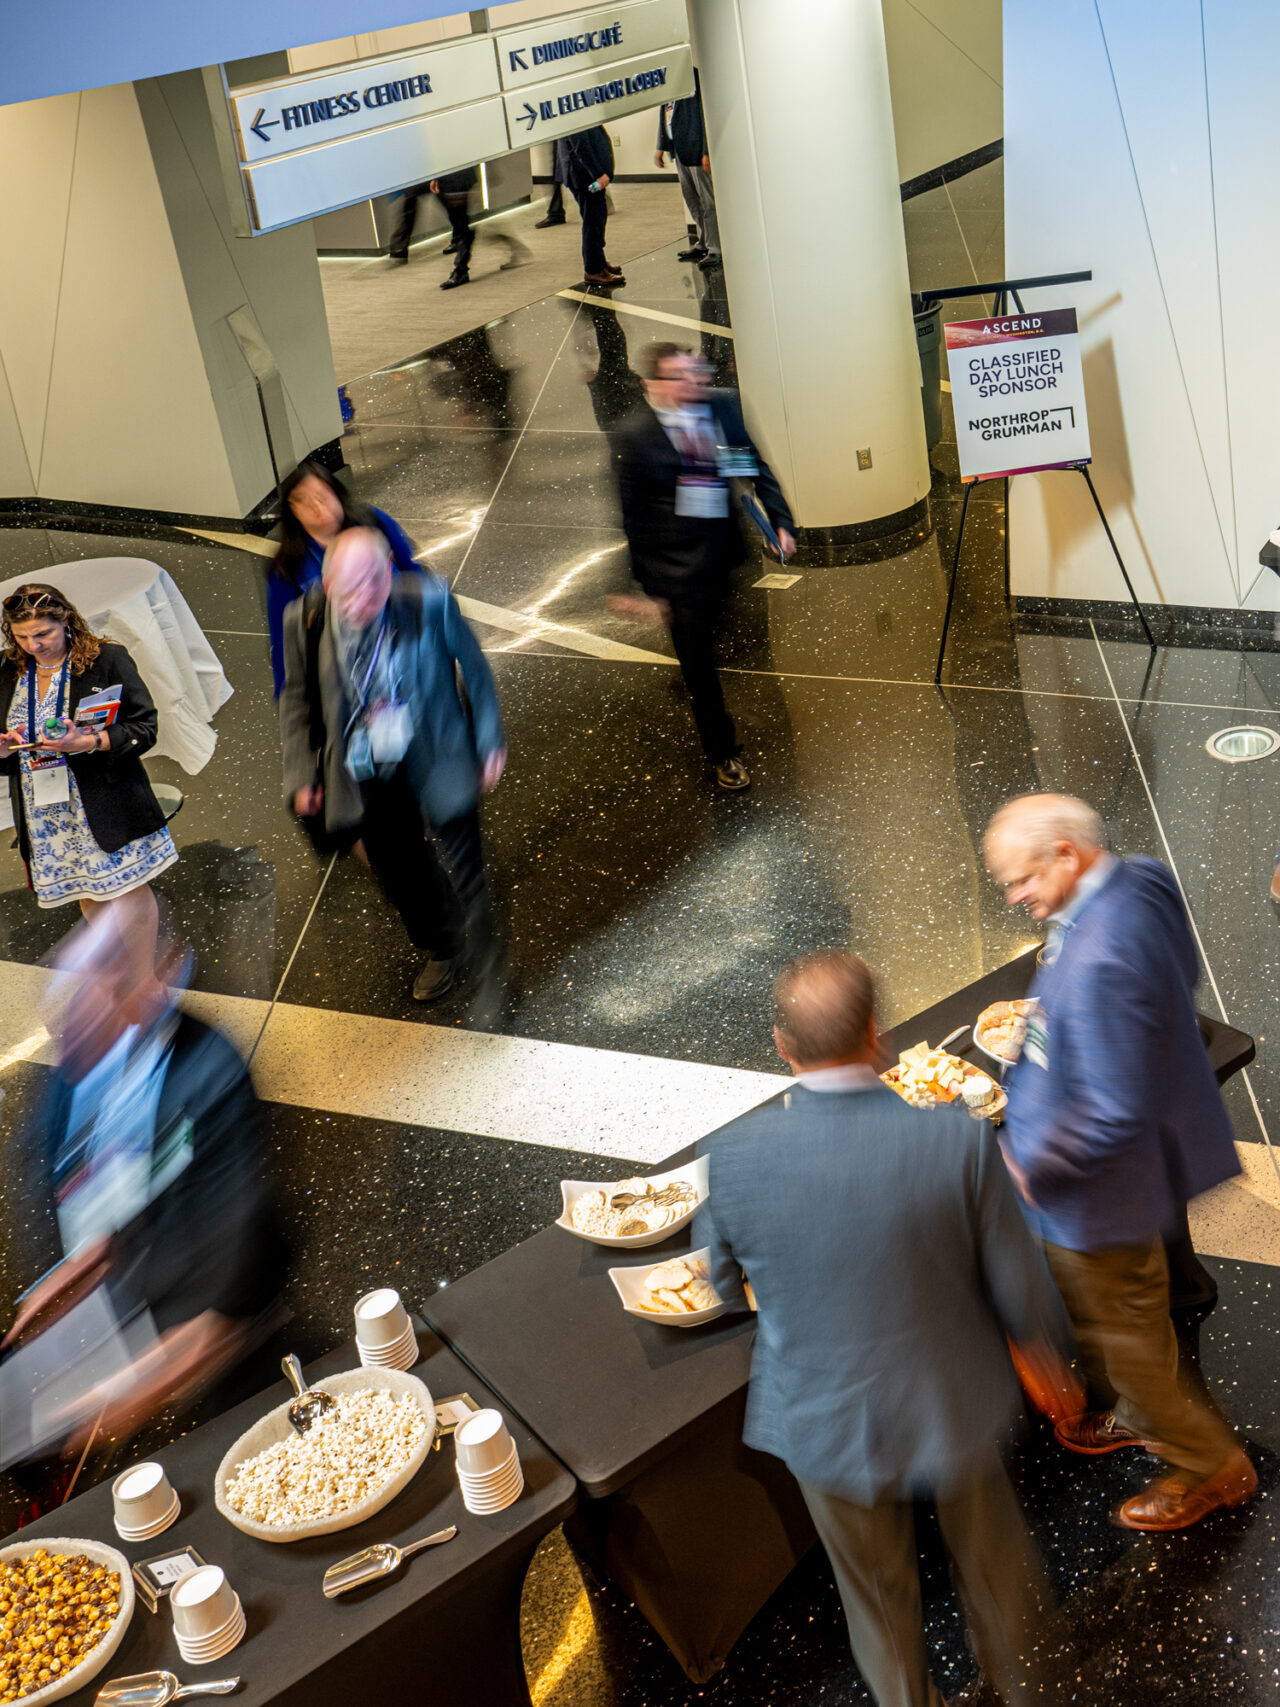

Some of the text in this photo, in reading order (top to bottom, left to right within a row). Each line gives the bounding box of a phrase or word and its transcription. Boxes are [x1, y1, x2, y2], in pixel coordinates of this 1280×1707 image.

[282, 73, 433, 131] FITNESS CENTER
[540, 66, 667, 121] N. ELEVATOR LOBBY
[982, 317, 1041, 335] ASCEND
[968, 348, 1062, 372] CLASSIFIED
[969, 361, 1064, 386] DAY LUNCH
[978, 377, 1058, 398] SPONSOR
[968, 409, 1050, 431] NORTHROP
[981, 419, 1062, 441] GRUMMAN
